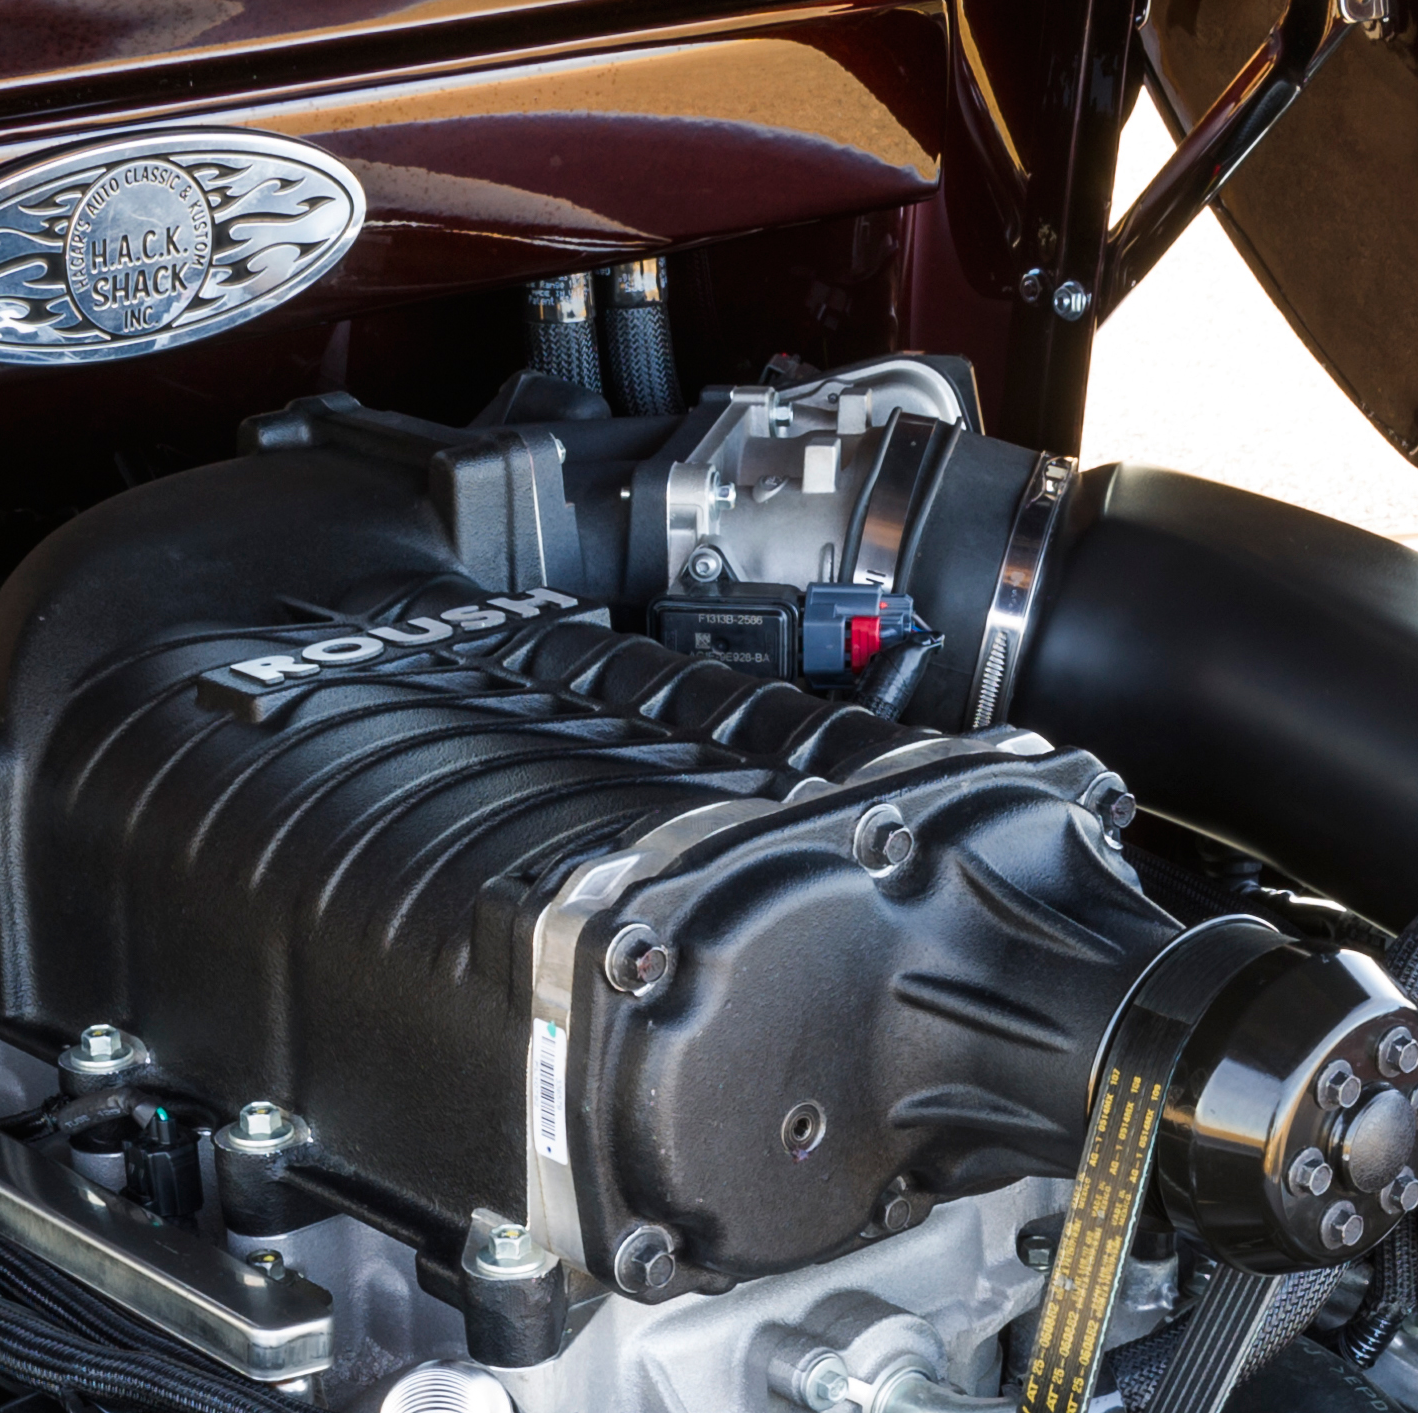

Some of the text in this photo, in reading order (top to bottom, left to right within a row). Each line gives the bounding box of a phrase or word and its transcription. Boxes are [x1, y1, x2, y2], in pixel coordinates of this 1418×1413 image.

[69, 165, 208, 294] HAGAR'S AUTO CLASSIC & KUSTOM
[91, 225, 189, 274] H.A.C.K.
[91, 262, 190, 311] SHACK
[123, 305, 159, 332] INC.
[229, 586, 579, 687] ROUSH
[1110, 1068, 1120, 1085] 107
[1151, 1084, 1161, 1100] 109
